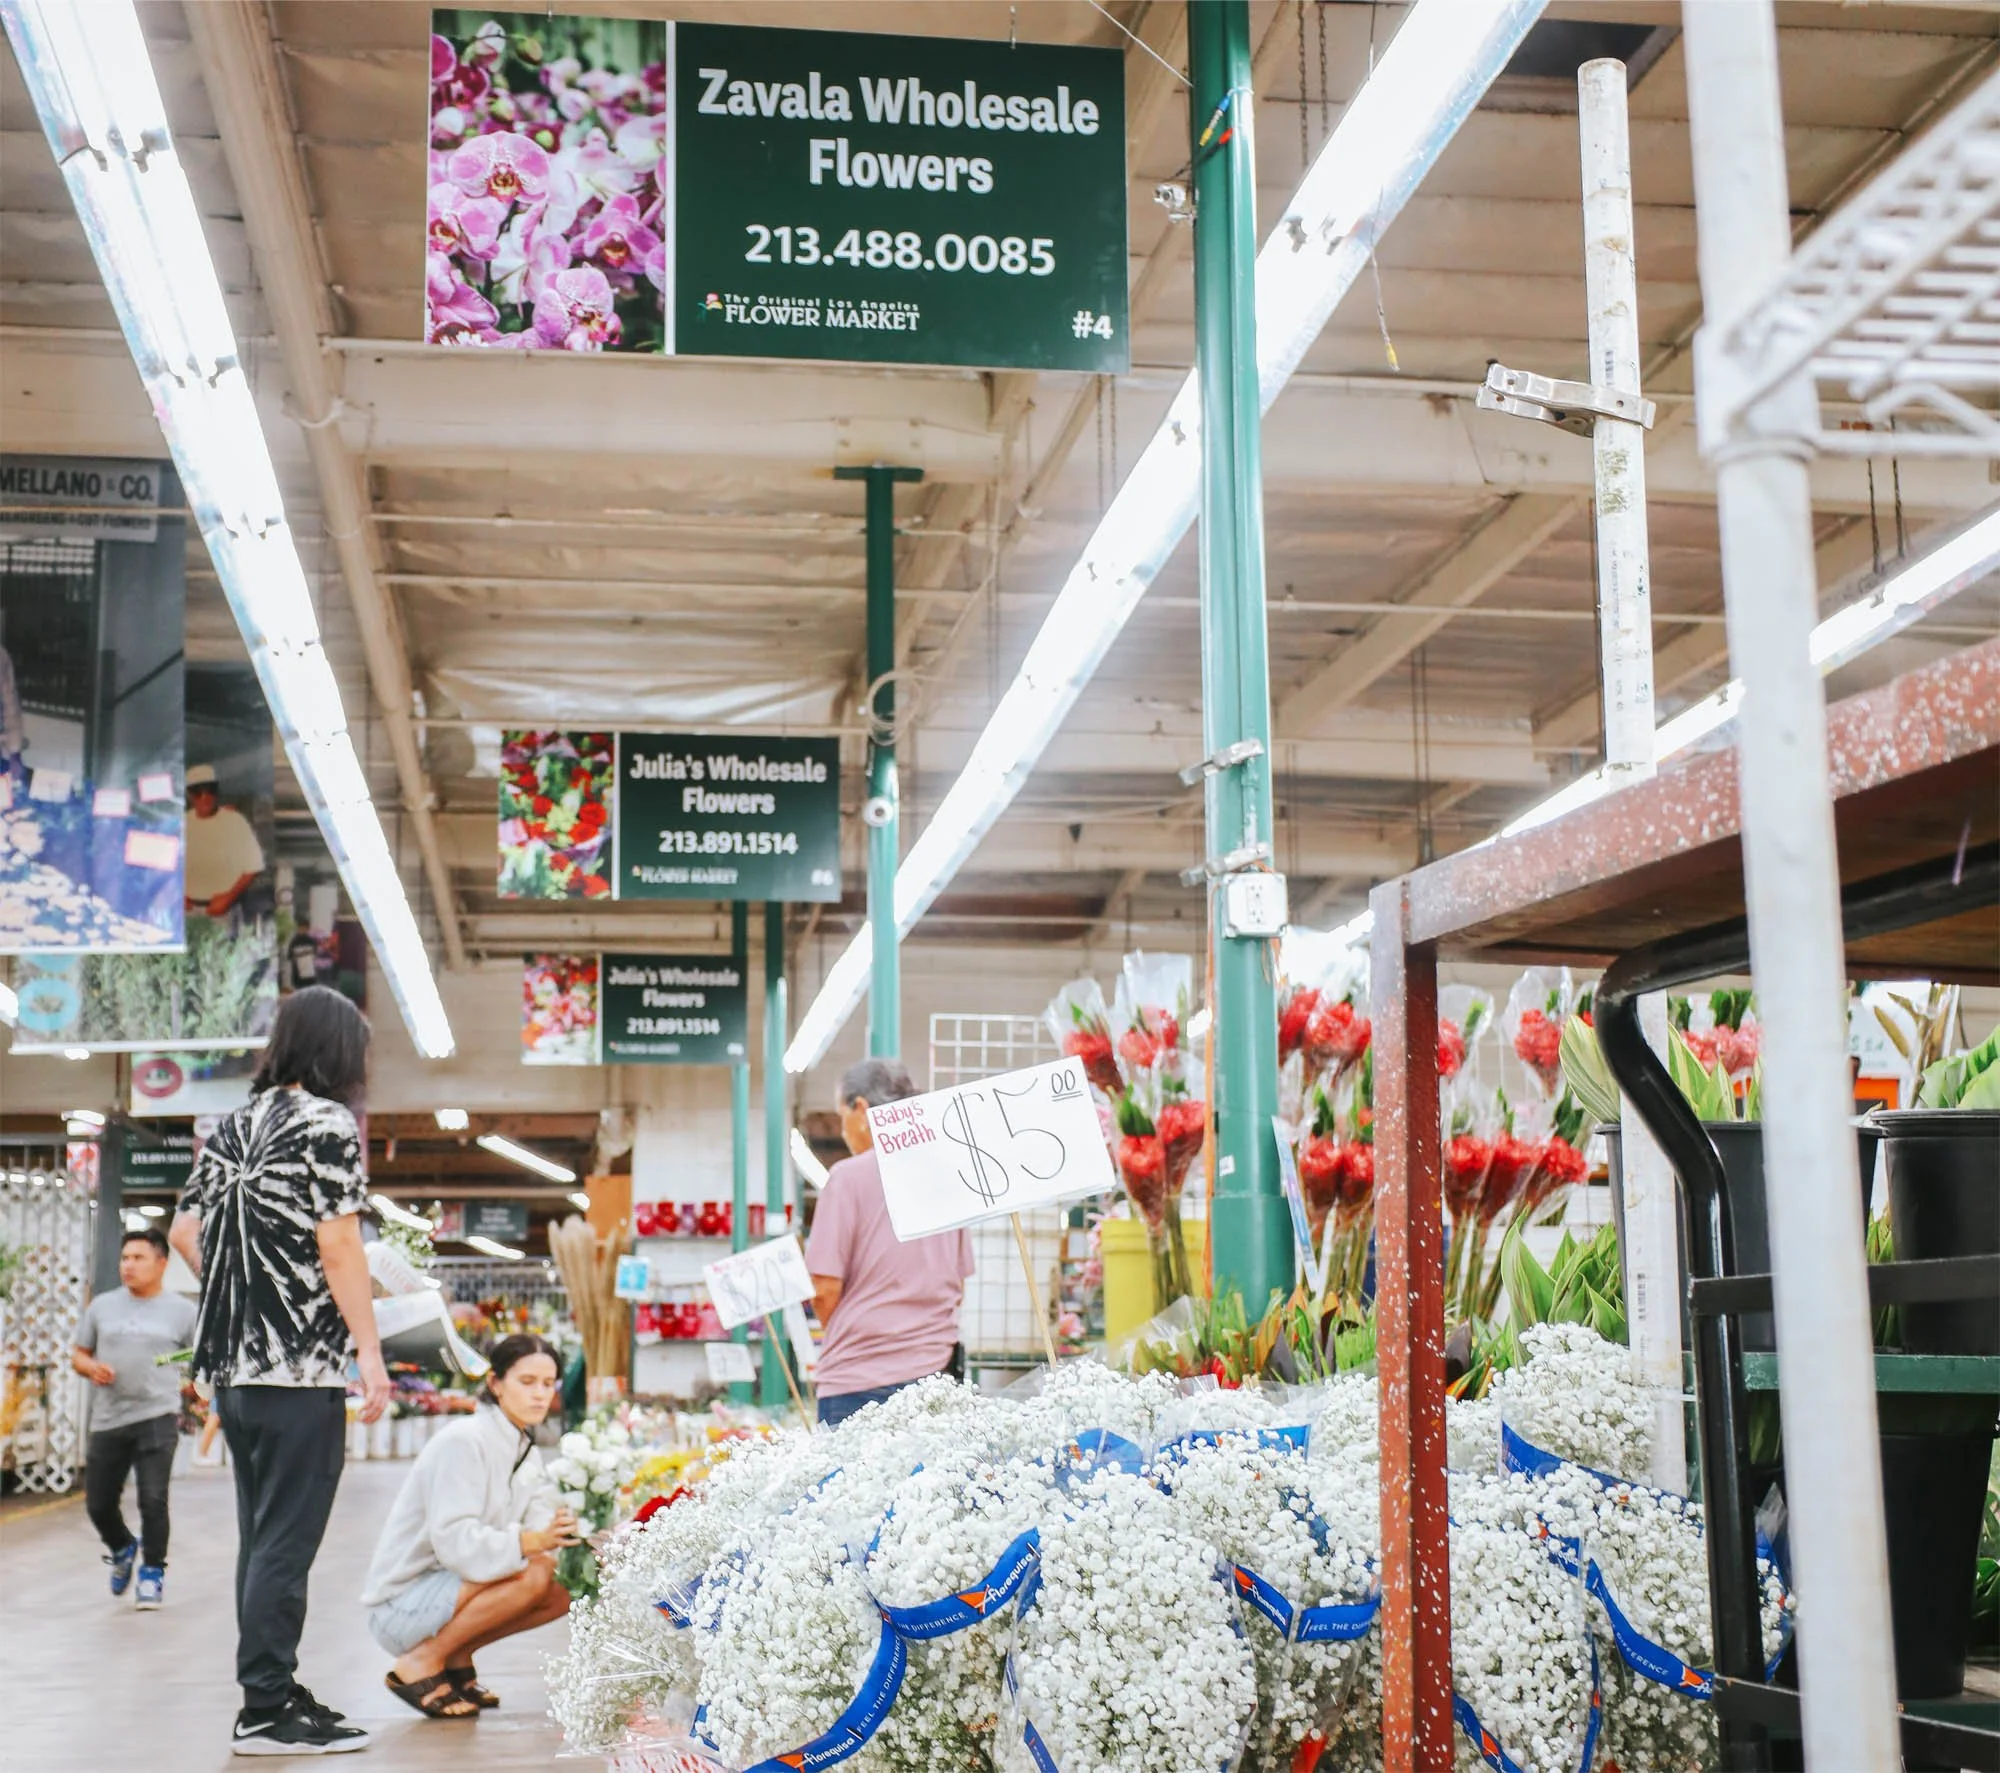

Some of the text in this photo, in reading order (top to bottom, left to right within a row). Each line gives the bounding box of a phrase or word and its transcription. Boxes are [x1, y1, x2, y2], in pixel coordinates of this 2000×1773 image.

[697, 67, 1100, 136] Zavala Wholesale
[808, 138, 994, 195] Flowers
[744, 224, 1056, 277] 213.488.0085
[724, 293, 919, 312] The Original Los Angeles
[725, 304, 920, 331] FLOWER MARKET
[1071, 310, 1113, 341] #4
[0, 467, 101, 499] MELLANO
[630, 752, 828, 783] Julia's Wholesale
[682, 786, 776, 815] Flowers
[658, 830, 799, 855] 213.891.1514
[872, 1100, 925, 1127] Baby's
[878, 1123, 937, 1154] Breath
